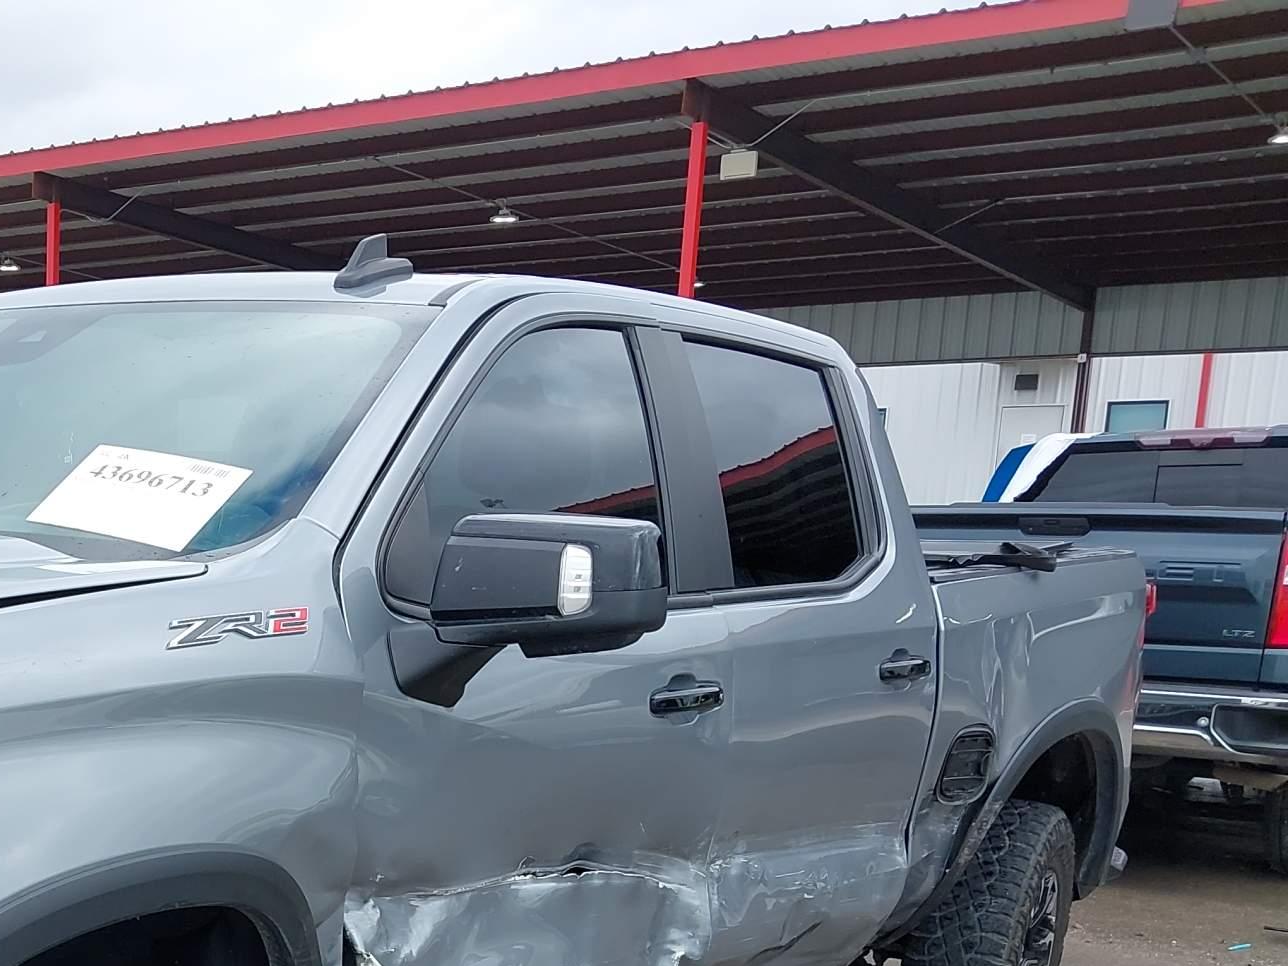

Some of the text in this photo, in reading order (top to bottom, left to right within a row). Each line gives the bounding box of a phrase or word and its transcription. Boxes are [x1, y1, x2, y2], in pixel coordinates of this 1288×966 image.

[89, 464, 214, 498] 43696713
[166, 606, 308, 650] ZR2
[1222, 629, 1256, 638] LTZ
